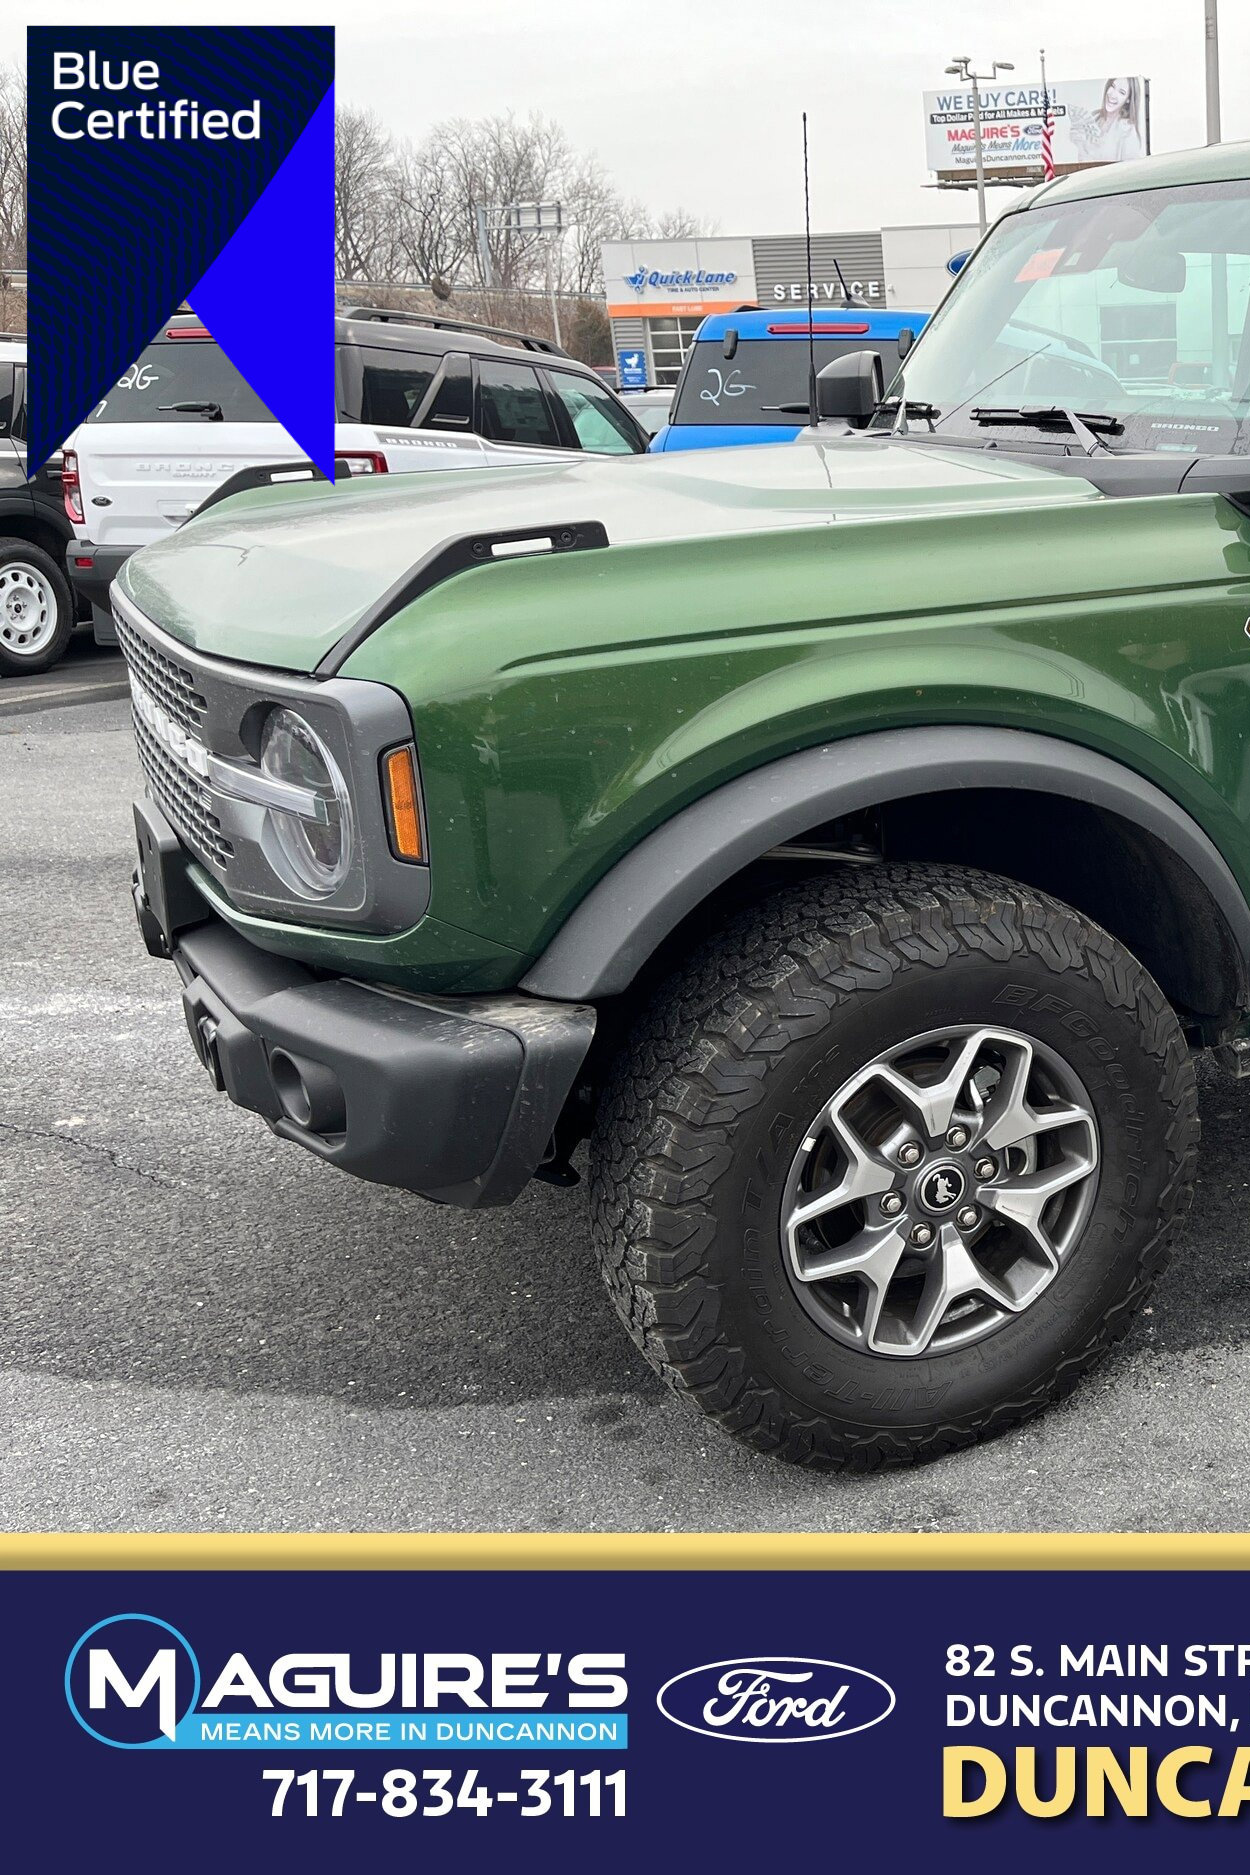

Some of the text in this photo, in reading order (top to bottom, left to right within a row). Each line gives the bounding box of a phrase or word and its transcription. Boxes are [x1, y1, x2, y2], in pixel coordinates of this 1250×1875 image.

[936, 95, 963, 111] WE
[967, 92, 1001, 110] BUY
[932, 114, 946, 124] Top
[946, 112, 967, 122] Dollar
[968, 111, 983, 121] Pd
[984, 110, 995, 120] for
[995, 109, 1006, 119] All
[1006, 107, 1029, 118] Makes
[1030, 107, 1037, 117] &
[952, 141, 986, 154] Maguirs
[987, 141, 1012, 151] Means
[955, 152, 1043, 165] MagusDuncannon.com
[647, 270, 736, 288] Quick Lane
[773, 281, 880, 301] SERVICE
[699, 368, 758, 406] 2G
[1150, 422, 1220, 432] BRONCO
[385, 438, 458, 448] BRONCO
[991, 982, 1146, 1245] BFGoodrich
[741, 1225, 954, 1412] All-Terrain
